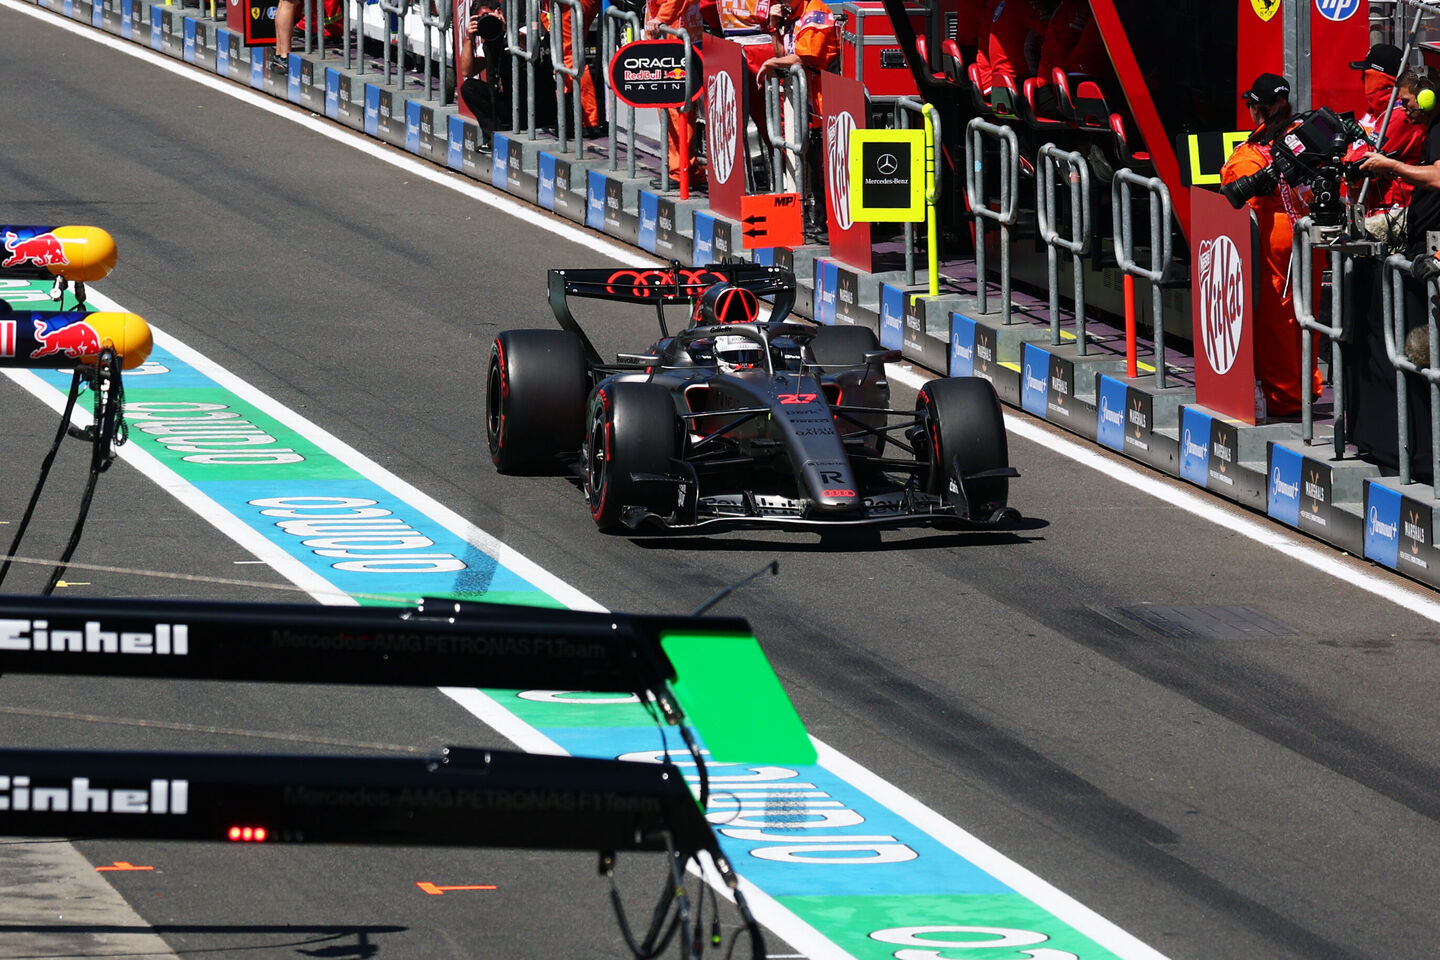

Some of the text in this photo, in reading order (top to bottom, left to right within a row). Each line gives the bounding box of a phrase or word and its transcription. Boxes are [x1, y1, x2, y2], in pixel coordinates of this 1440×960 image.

[624, 82, 681, 91] RACIN
[864, 177, 909, 186] Mercedes-Benz
[777, 393, 818, 405] 27
[1213, 441, 1232, 462] MARSHALS
[1272, 466, 1299, 500] Paramount+
[1305, 480, 1325, 502] MARSHALS
[1369, 505, 1398, 541] Paramount+
[1404, 520, 1425, 545] MARSHALS
[271, 629, 422, 654] Mercedes-AMG
[424, 635, 532, 658] PETRONAS
[283, 785, 455, 810] Mercedes-AMG
[456, 789, 576, 811] PETRONAS
